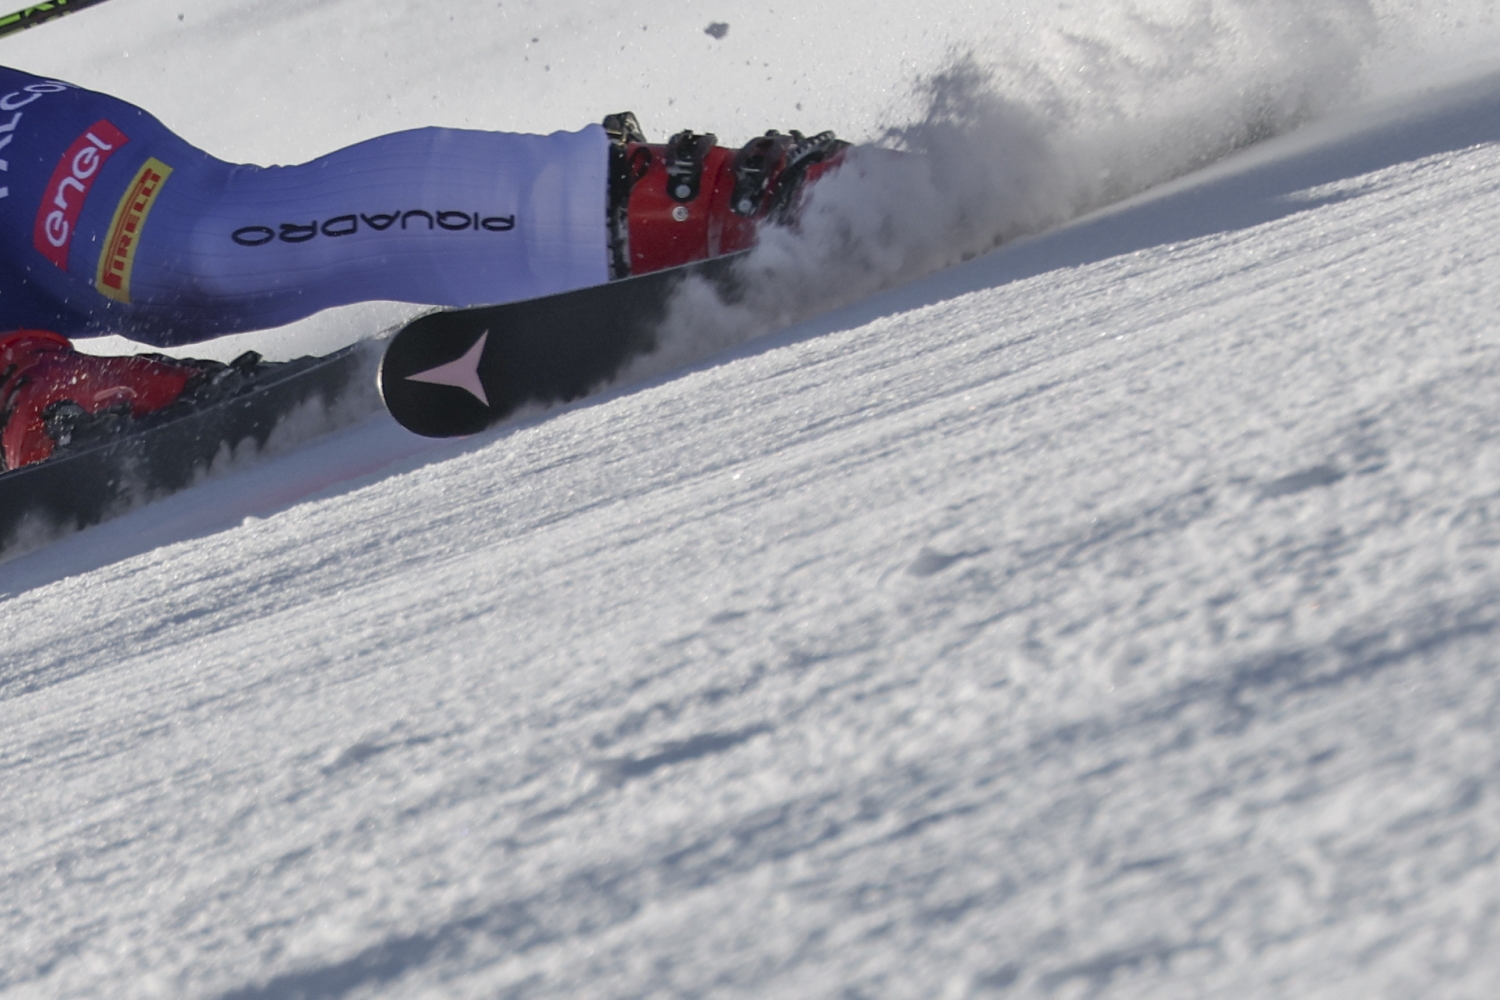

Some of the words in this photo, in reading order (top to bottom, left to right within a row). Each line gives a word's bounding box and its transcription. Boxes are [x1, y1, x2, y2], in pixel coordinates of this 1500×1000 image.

[45, 132, 112, 247] enel
[102, 167, 162, 290] PIRELLI
[232, 209, 515, 246] PIQUADRO
